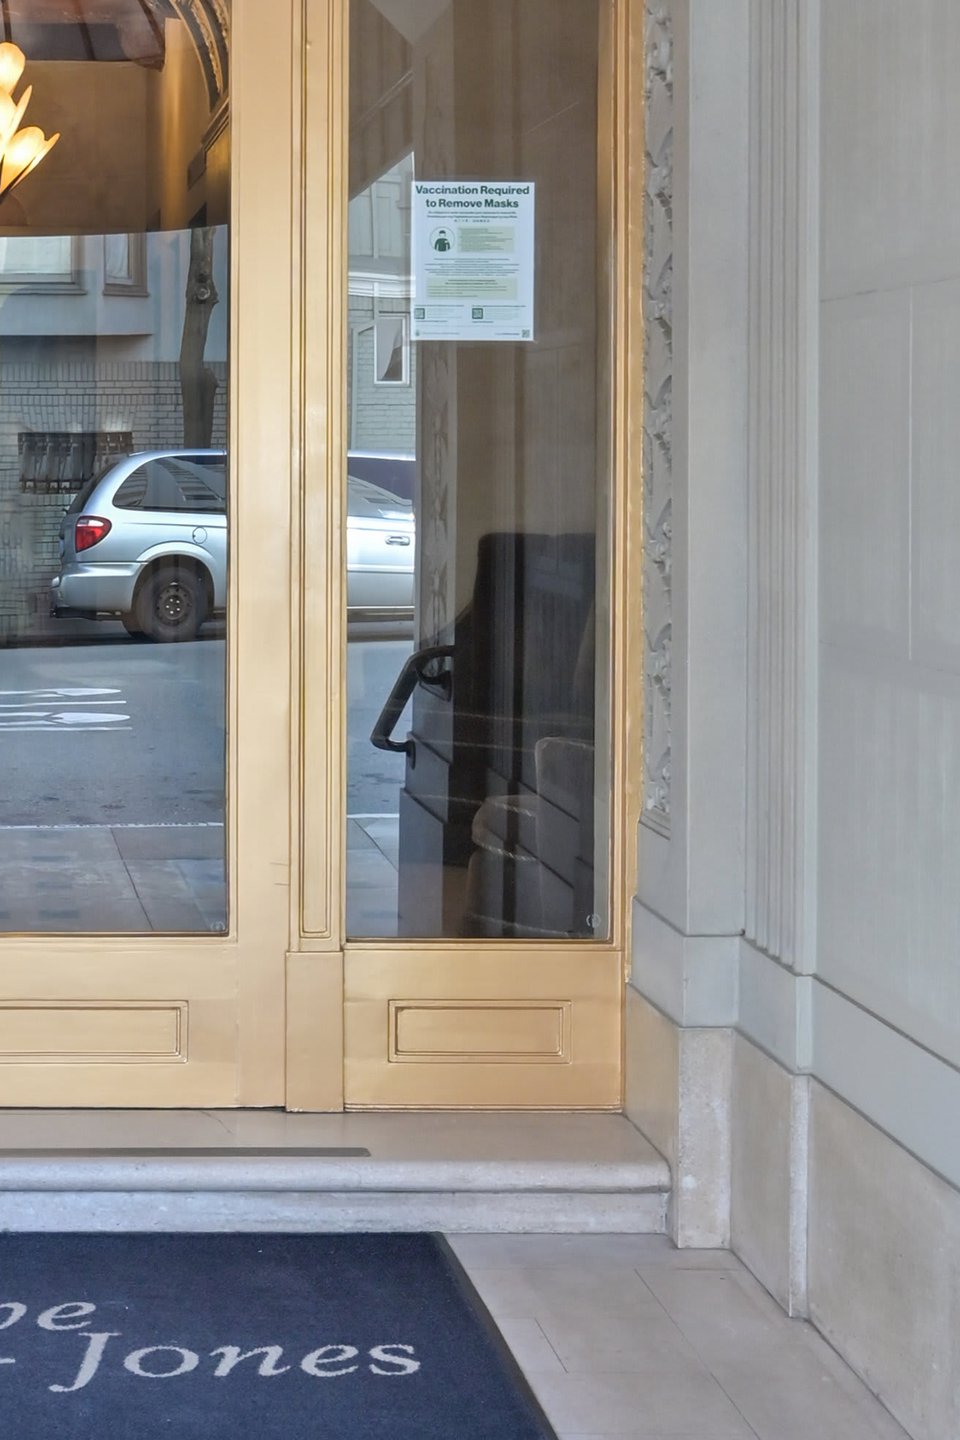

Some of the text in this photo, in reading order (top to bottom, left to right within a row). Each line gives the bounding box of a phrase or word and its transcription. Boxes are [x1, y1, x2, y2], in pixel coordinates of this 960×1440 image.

[415, 185, 530, 196] Vaccination Required
[426, 199, 519, 208] to Remove Masks
[48, 1330, 423, 1394] Jones
